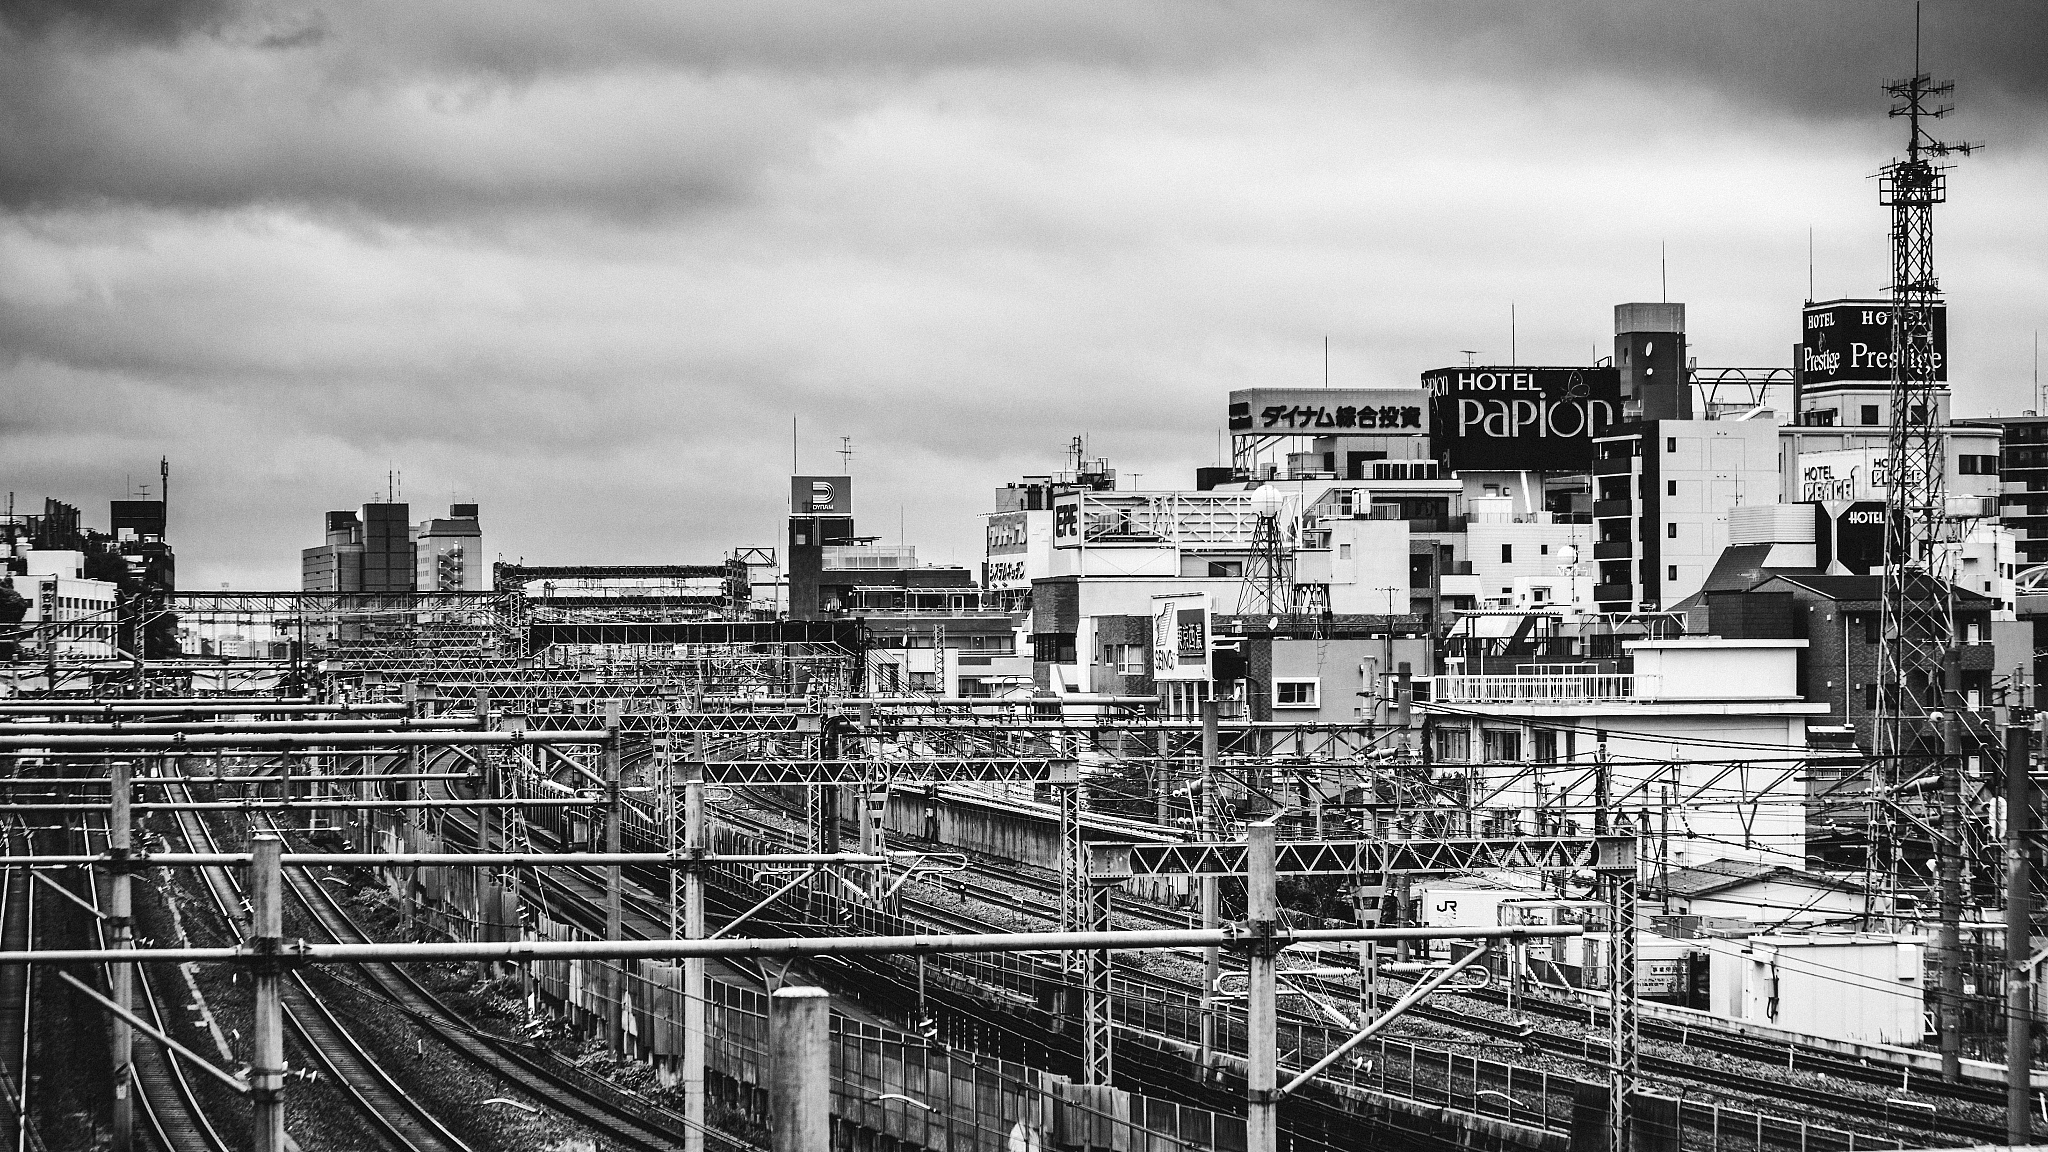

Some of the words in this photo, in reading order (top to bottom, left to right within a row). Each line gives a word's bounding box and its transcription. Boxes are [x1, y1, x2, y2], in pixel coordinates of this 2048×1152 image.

[1807, 312, 1835, 329] HOTEL
[1804, 347, 1840, 375] Prestige
[1458, 373, 1542, 391] HOTEL
[1261, 405, 1421, 428] ダイナム綜合投資
[1804, 465, 1834, 481] HOTEL
[1849, 511, 1885, 524] HOTEL
[990, 561, 1024, 582] システムキッチン
[1436, 900, 1457, 912] JR
